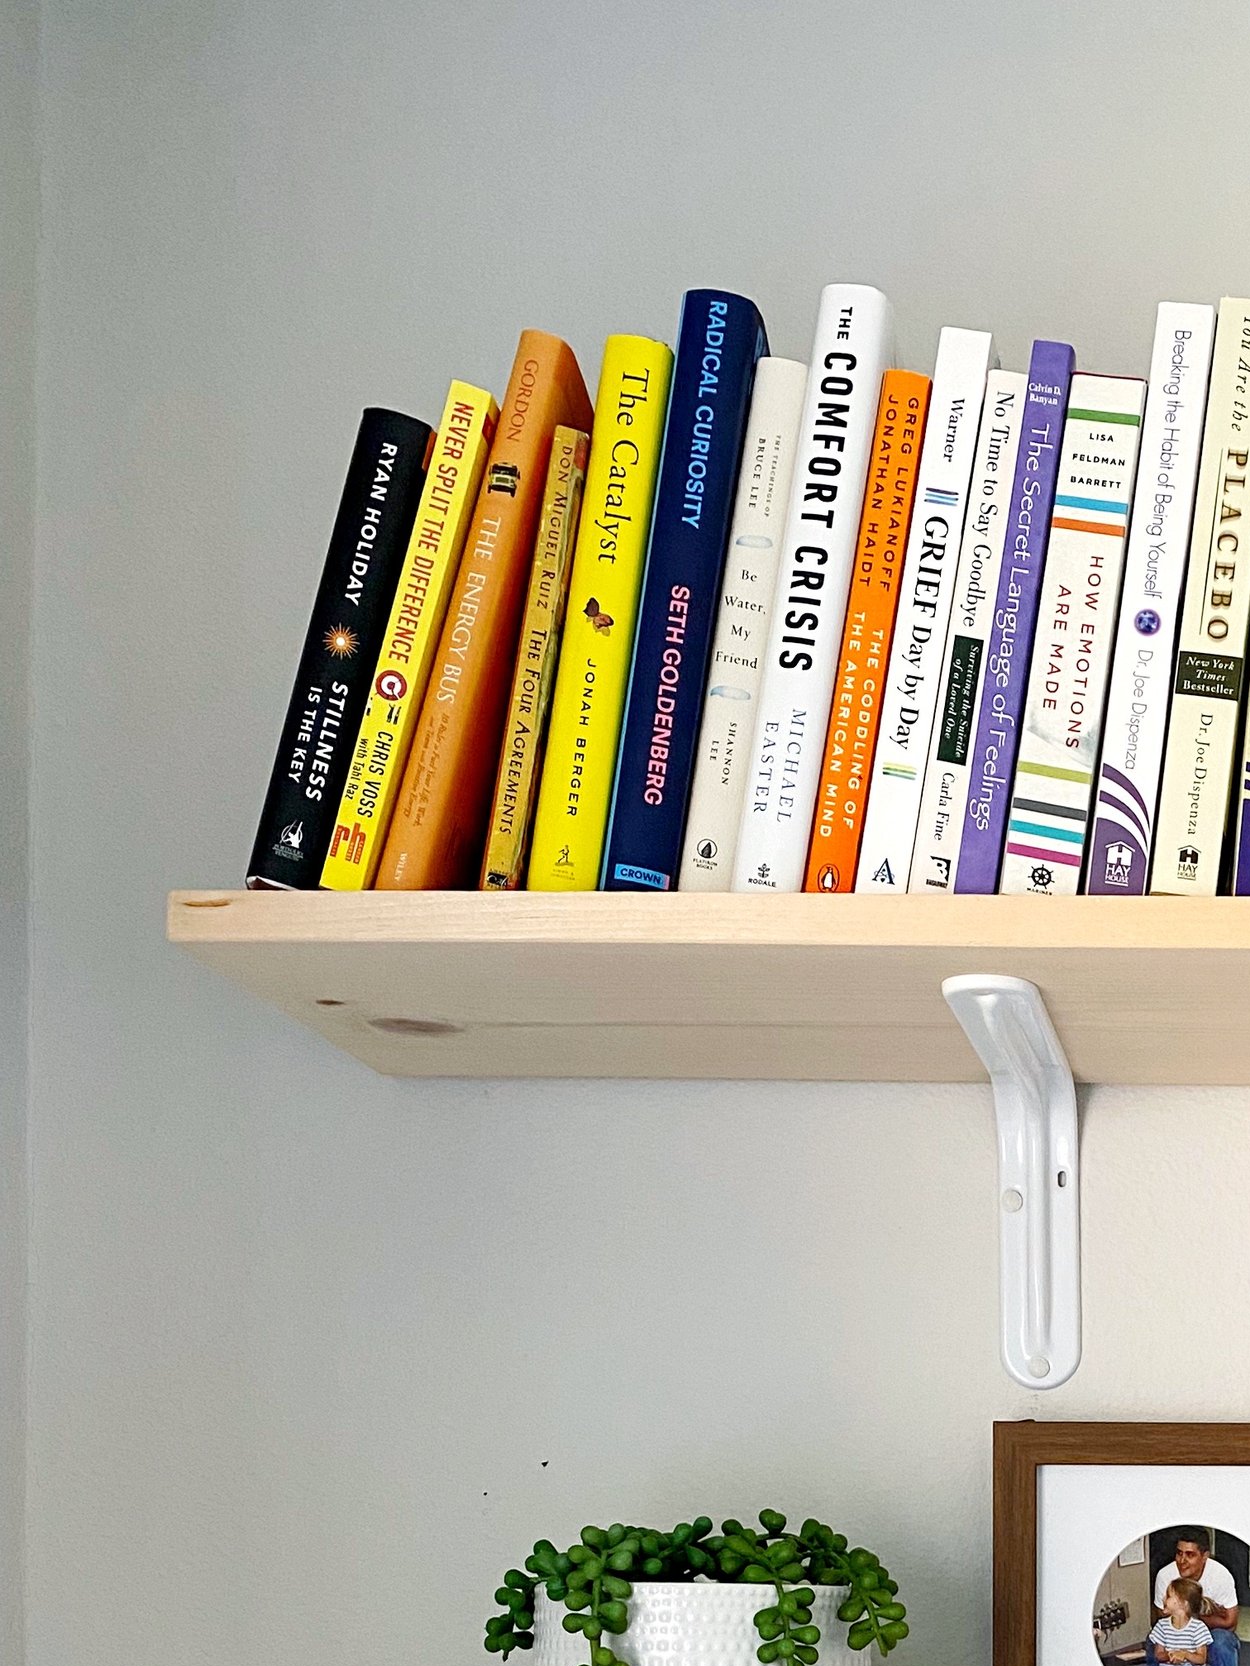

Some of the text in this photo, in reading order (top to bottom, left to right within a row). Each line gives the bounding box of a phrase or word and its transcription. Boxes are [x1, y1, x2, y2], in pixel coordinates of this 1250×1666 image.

[506, 359, 539, 442] GORDON
[681, 301, 728, 529] RADICAL CURIOSITY
[943, 398, 966, 462] Warner
[1072, 453, 1126, 467] FELDMAN
[1089, 433, 1114, 443] LISA
[1231, 401, 1249, 432] the
[344, 442, 398, 607] RYAN HOLIDAY
[595, 368, 649, 565] The Catalyst
[748, 437, 766, 509] BRUCE LEE
[779, 306, 857, 671] THE COMFORT CRISIS
[859, 394, 899, 587] JONATHAN HAIDT
[879, 397, 919, 593] GREG LUKIANOFF
[962, 391, 1016, 628] No Time to Say Goodbye
[1070, 475, 1122, 489] BARRETT
[1143, 329, 1192, 600] Breaking the Habit of Being Yourself
[388, 401, 475, 664] NEVER SPLIT THE DIFFERENCE
[741, 569, 758, 583] Be
[1207, 447, 1249, 642] PLACEBO
[436, 516, 501, 704] THE ENERGY BUS
[499, 445, 572, 835] DON MIGUEL RUIZ THE FOUR AGREEMENTS
[715, 650, 758, 670] Friend
[731, 624, 751, 642] My
[889, 515, 950, 750] GRIEF Day by Day
[969, 423, 1054, 831] The Secret Language of Feelings
[1042, 584, 1071, 711] ARE MADE
[1065, 555, 1104, 749] HOW EMOTIONS
[1185, 656, 1235, 671] New York
[288, 686, 323, 783] IS THE KEY
[643, 585, 691, 806] SETH GOLDENBERG
[819, 612, 866, 838] THE AMERICAN MIND
[843, 629, 884, 829] THE CODDLING OF
[1124, 649, 1153, 770] Dr. Joe Dispenza
[1183, 680, 1235, 696] Bestseller
[1196, 669, 1227, 682] Times
[305, 681, 348, 801] STILLNESS
[345, 738, 369, 800] with Tahl Raz
[357, 731, 394, 818] CHRIS VOSS
[566, 658, 597, 816] JONAH BERGER
[709, 740, 720, 761] LEE
[721, 722, 737, 785] SHANNON
[753, 721, 780, 813] EASTER
[776, 708, 807, 823] MICHAEL
[1187, 713, 1213, 835] Dr. Joe Dispenza
[934, 772, 955, 841] Carla Fine
[620, 867, 661, 885] CROWN
